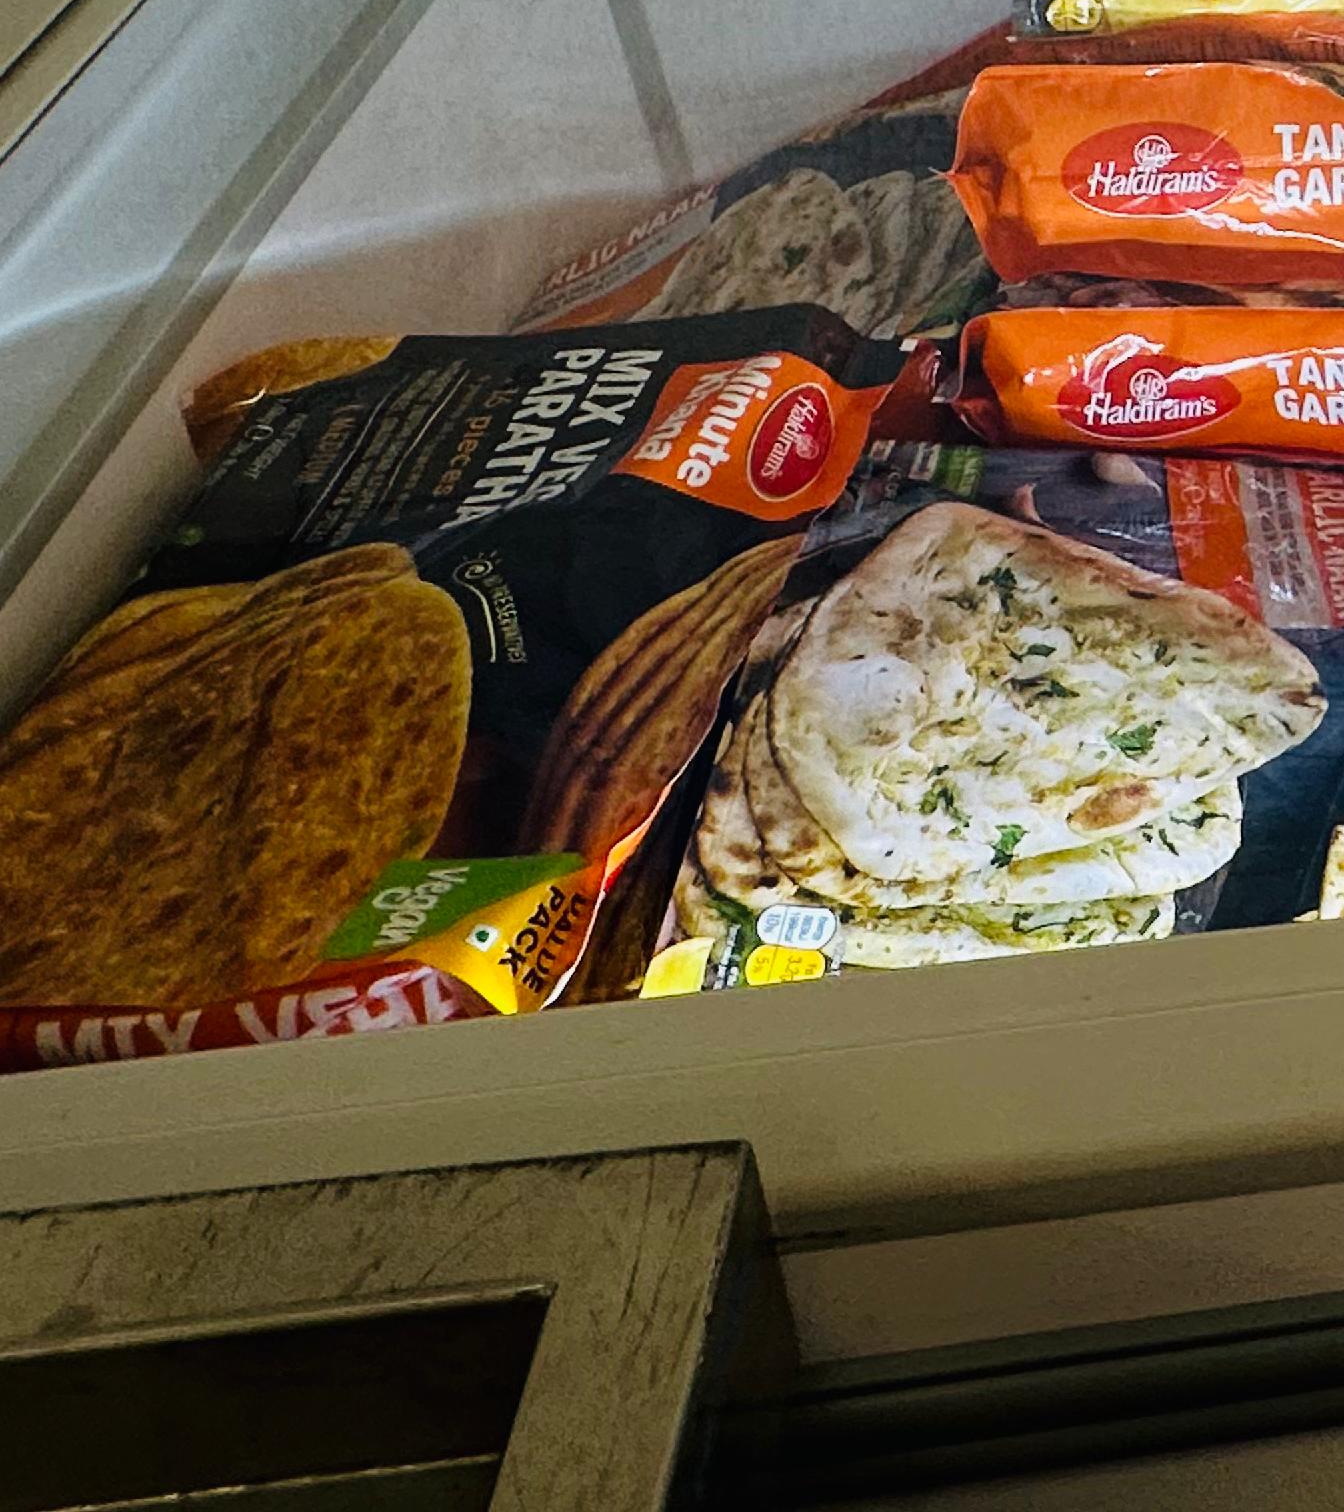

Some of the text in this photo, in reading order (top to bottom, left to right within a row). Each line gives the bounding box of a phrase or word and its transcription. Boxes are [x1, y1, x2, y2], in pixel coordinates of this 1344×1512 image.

[1087, 162, 1219, 198] Haldiram's
[568, 349, 663, 427] MIX
[677, 355, 782, 487] Minute
[1083, 392, 1218, 427] Haldiram's
[441, 348, 605, 530] PARATHA
[760, 393, 819, 481] Haldiram's
[373, 866, 470, 946] Vegan
[498, 883, 562, 980] PACK
[521, 891, 587, 994] VALUE
